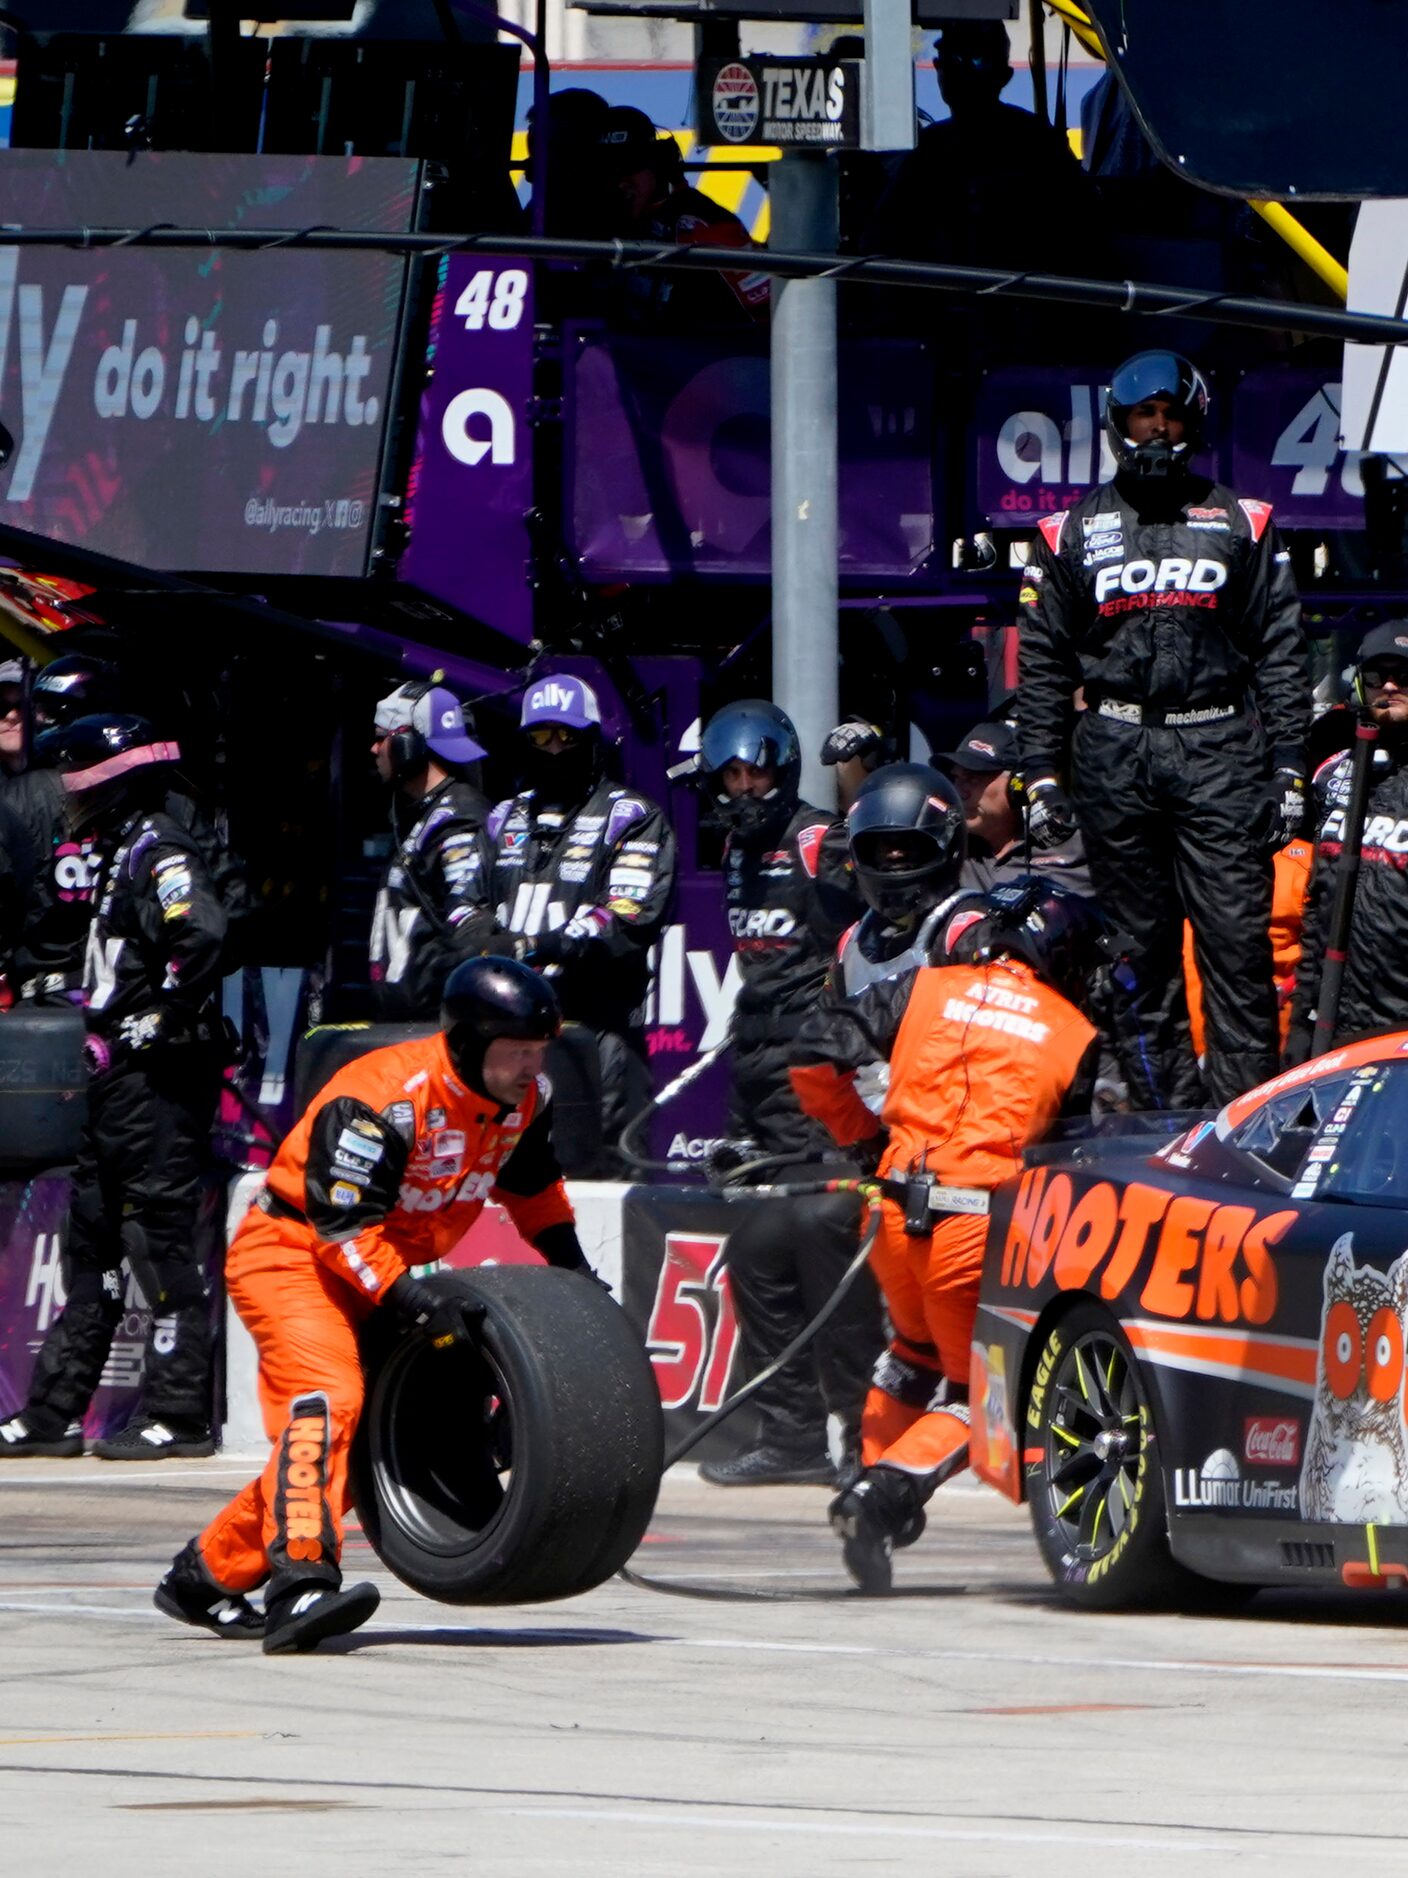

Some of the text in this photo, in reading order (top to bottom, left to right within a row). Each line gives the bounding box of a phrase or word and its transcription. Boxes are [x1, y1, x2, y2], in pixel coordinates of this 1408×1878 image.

[762, 66, 845, 121] TEXAS
[762, 122, 844, 141] MOTOR SPEEDWAY
[455, 269, 528, 331] 48
[94, 316, 379, 447] do it right.
[442, 388, 515, 465] a
[244, 498, 320, 535] @allyracing
[1095, 558, 1227, 602] FORD
[1098, 592, 1218, 617] PERFORMANCE
[532, 683, 574, 711] ally
[943, 998, 1049, 1044] HOOTERS
[1001, 1166, 1299, 1325] HOOTERS
[645, 1231, 741, 1414] 51
[1027, 1329, 1064, 1430] EAGLE
[1246, 1422, 1298, 1460] Coca-Cola
[285, 1416, 325, 1562] HOOTERS
[1243, 1480, 1298, 1509] UniFirst
